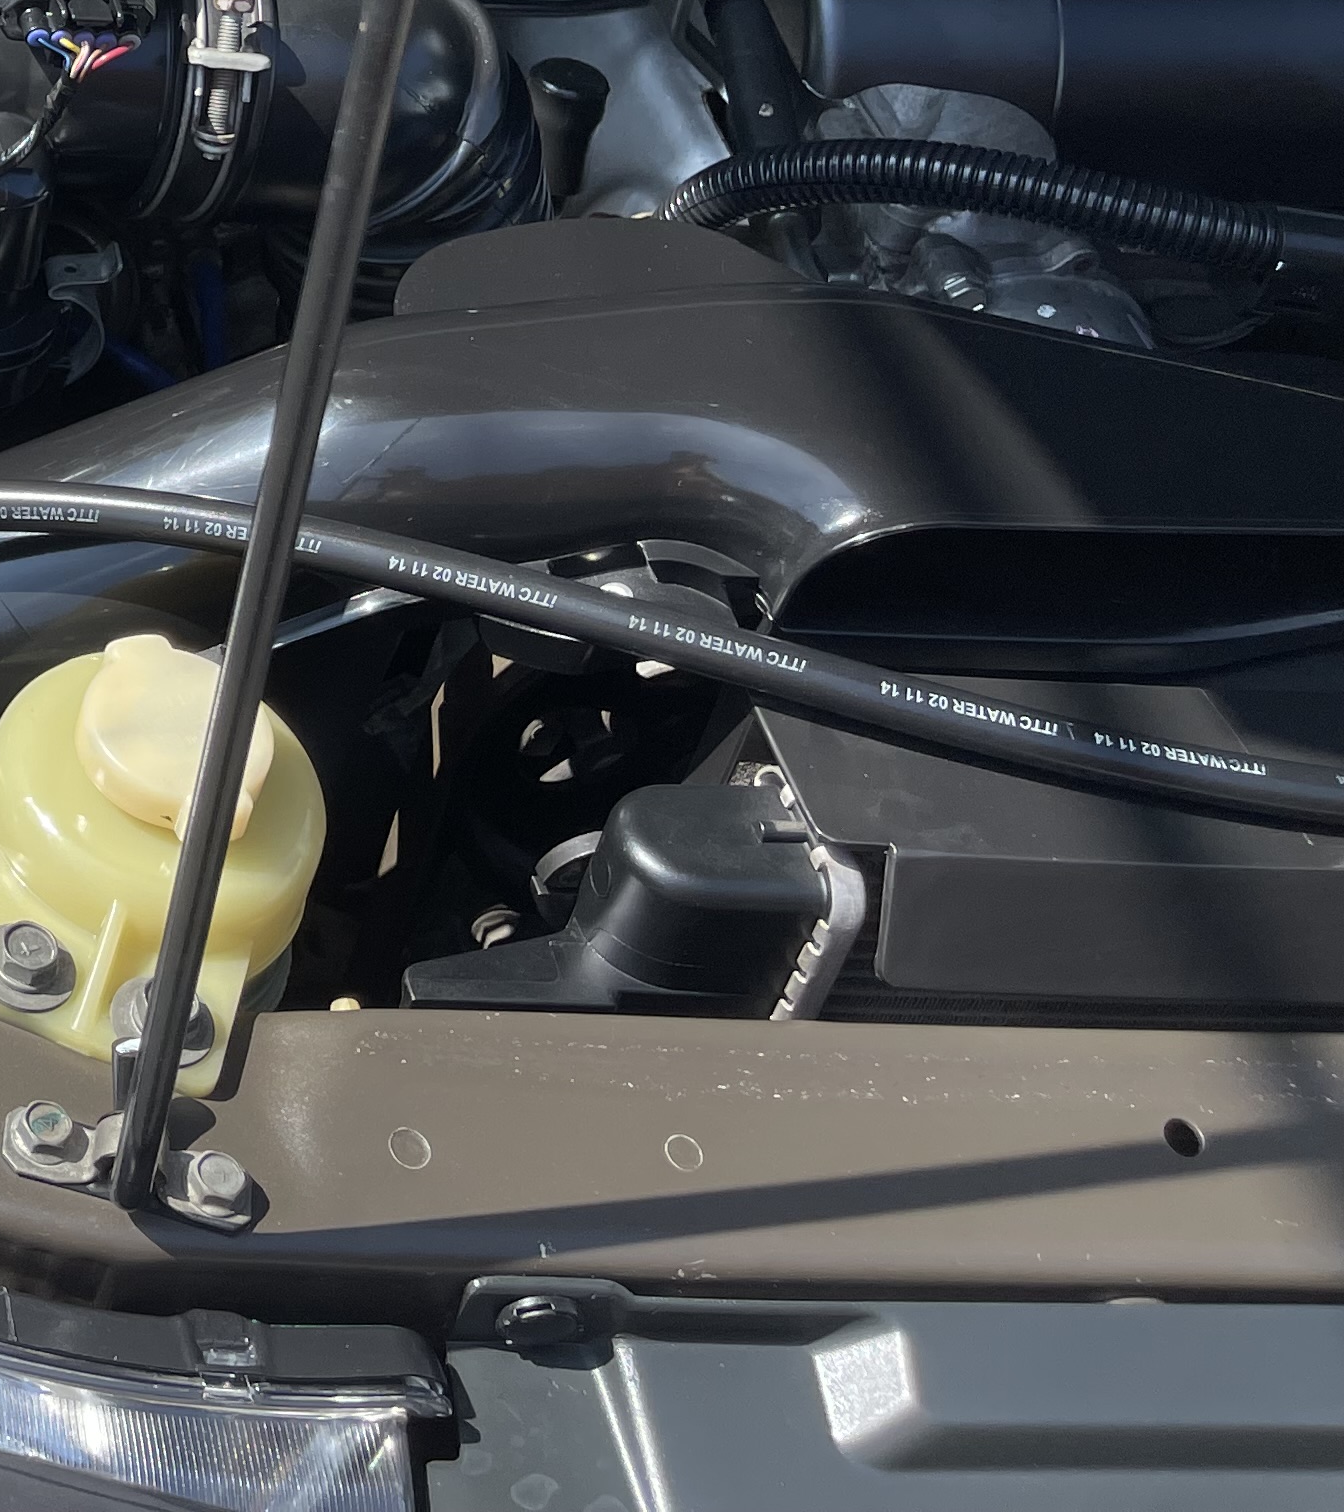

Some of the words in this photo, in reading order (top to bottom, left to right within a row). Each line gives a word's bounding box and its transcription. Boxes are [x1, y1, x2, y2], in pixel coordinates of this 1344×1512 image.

[11, 505, 65, 521] WATER
[162, 516, 180, 531] 14
[184, 518, 201, 534] 11
[204, 521, 223, 537] 02
[388, 555, 407, 573] 14
[411, 560, 429, 578] 11
[432, 565, 452, 583] 02
[454, 569, 515, 599] WATER
[628, 614, 648, 632] 14
[652, 621, 671, 639] 11
[675, 626, 696, 644] 02
[699, 632, 763, 663] WATER
[879, 680, 901, 698] 14
[905, 687, 925, 704] 11
[928, 692, 949, 711] 02
[952, 698, 1017, 728] WATER
[1093, 731, 1114, 748] 14
[1119, 736, 1137, 753] 11
[1140, 741, 1162, 758] 02
[1163, 745, 1229, 771] WATER
